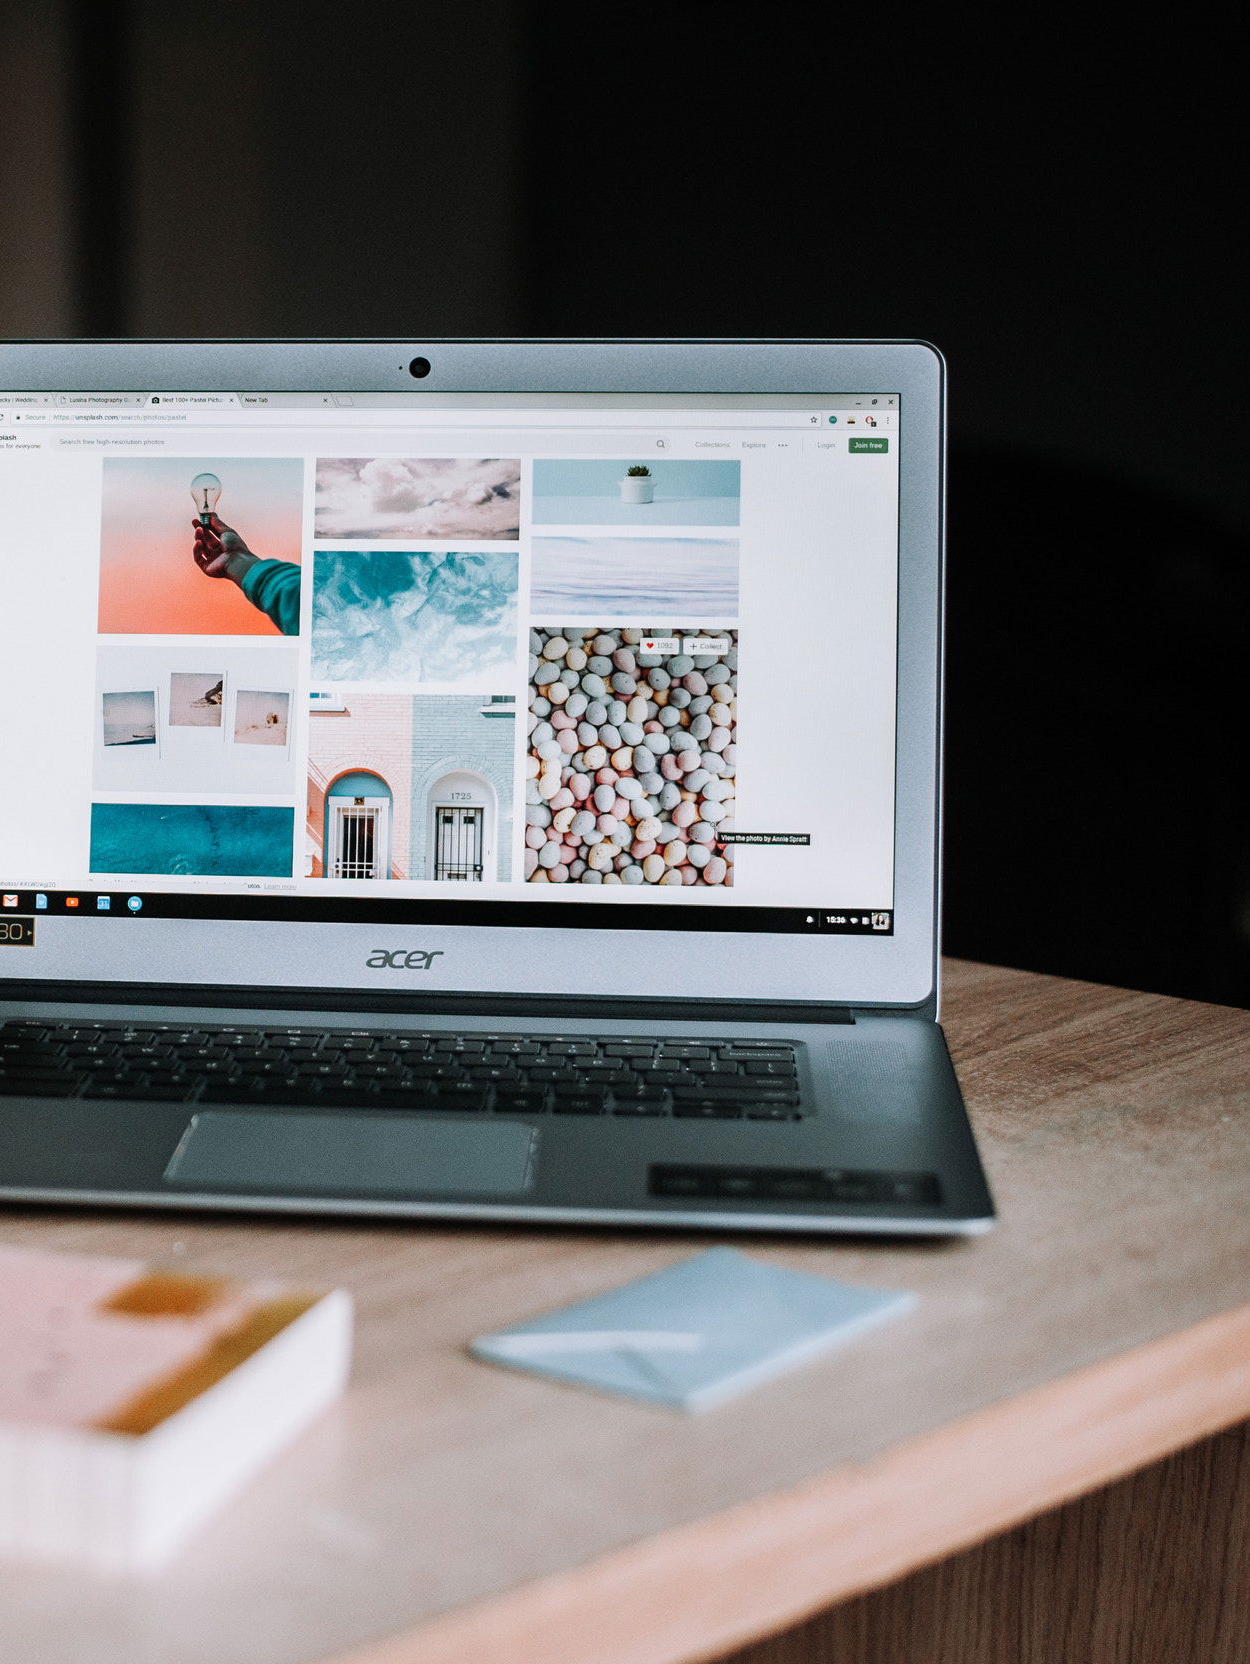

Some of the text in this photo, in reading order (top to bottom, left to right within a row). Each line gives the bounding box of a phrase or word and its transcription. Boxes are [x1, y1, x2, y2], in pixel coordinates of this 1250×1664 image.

[88, 397, 123, 405] Photography
[694, 440, 767, 450] Collections Explore
[853, 441, 883, 449] Join free
[450, 791, 473, 801] 1725
[720, 834, 735, 842] View
[735, 834, 746, 842] the
[746, 835, 763, 843] photo
[763, 835, 772, 843] by
[789, 836, 808, 844] Spratt
[365, 949, 445, 970] acer
